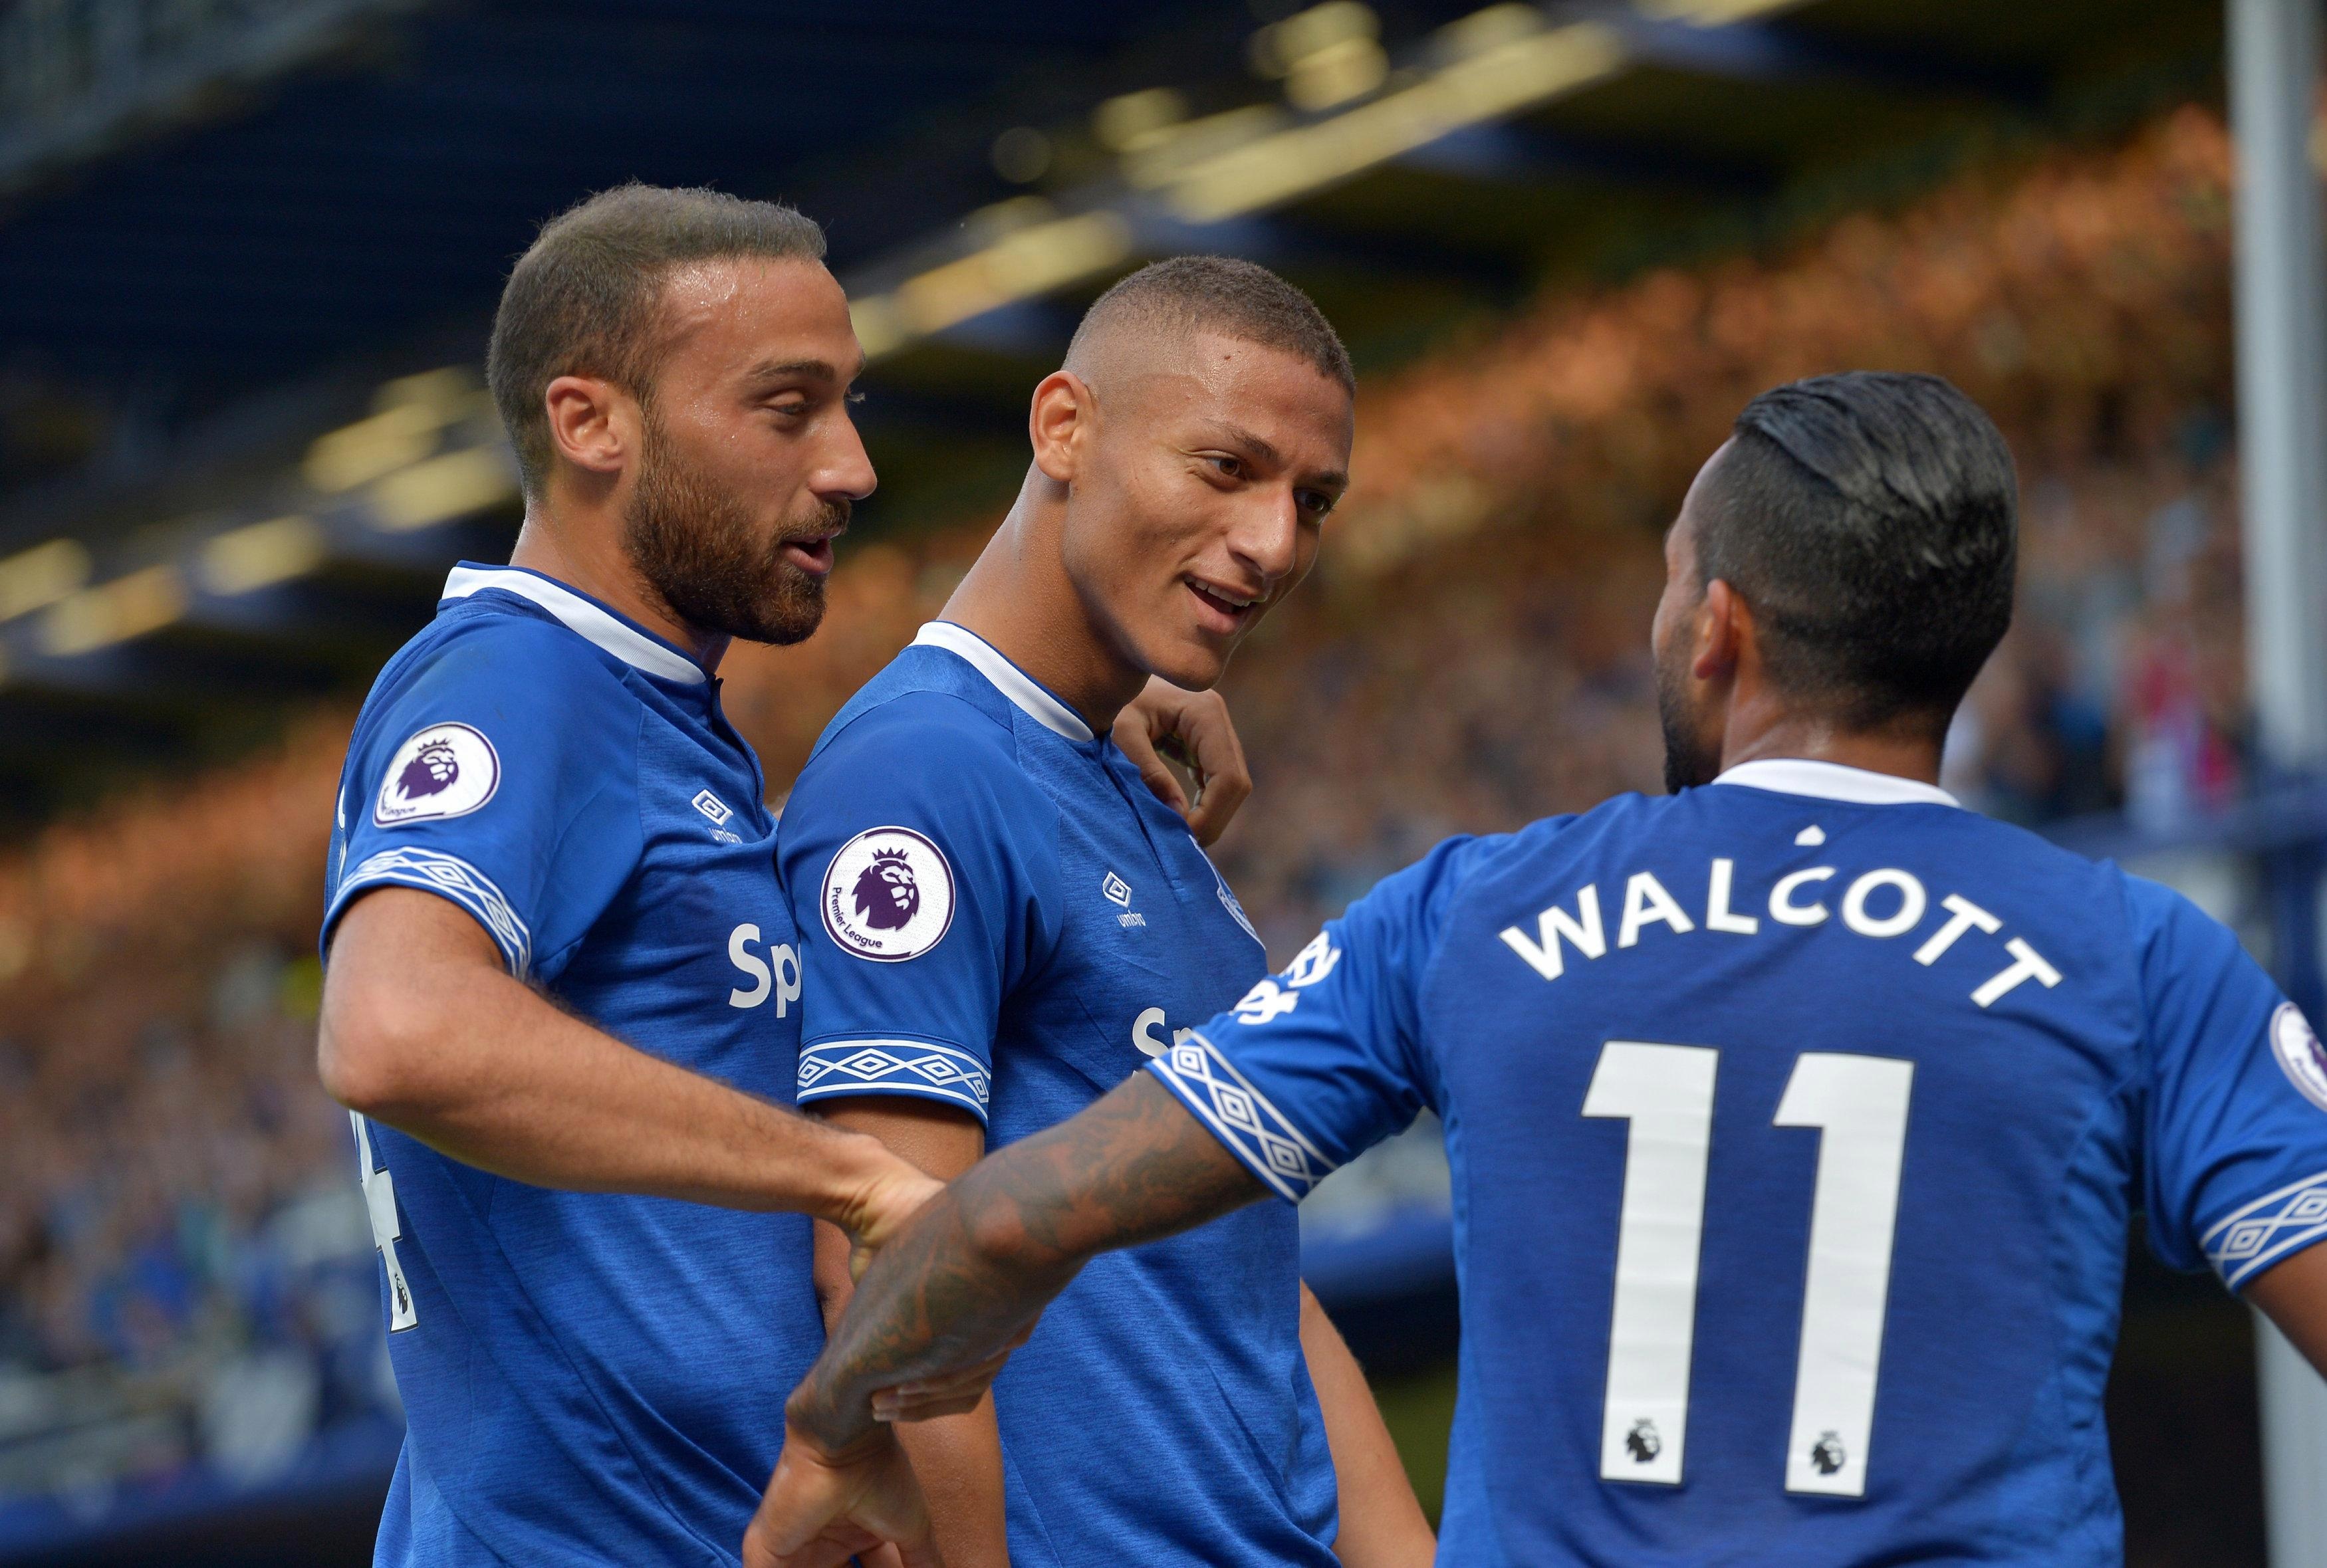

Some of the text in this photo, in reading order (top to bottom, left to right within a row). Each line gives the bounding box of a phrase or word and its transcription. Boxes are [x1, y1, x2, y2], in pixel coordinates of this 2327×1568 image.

[707, 827, 743, 844] umbro
[832, 887, 883, 948] Premier League
[1116, 909, 1146, 927] umbro
[1499, 857, 2063, 1008] WALCOTT
[728, 923, 802, 1018] Sp
[1580, 1040, 1915, 1497] 11
